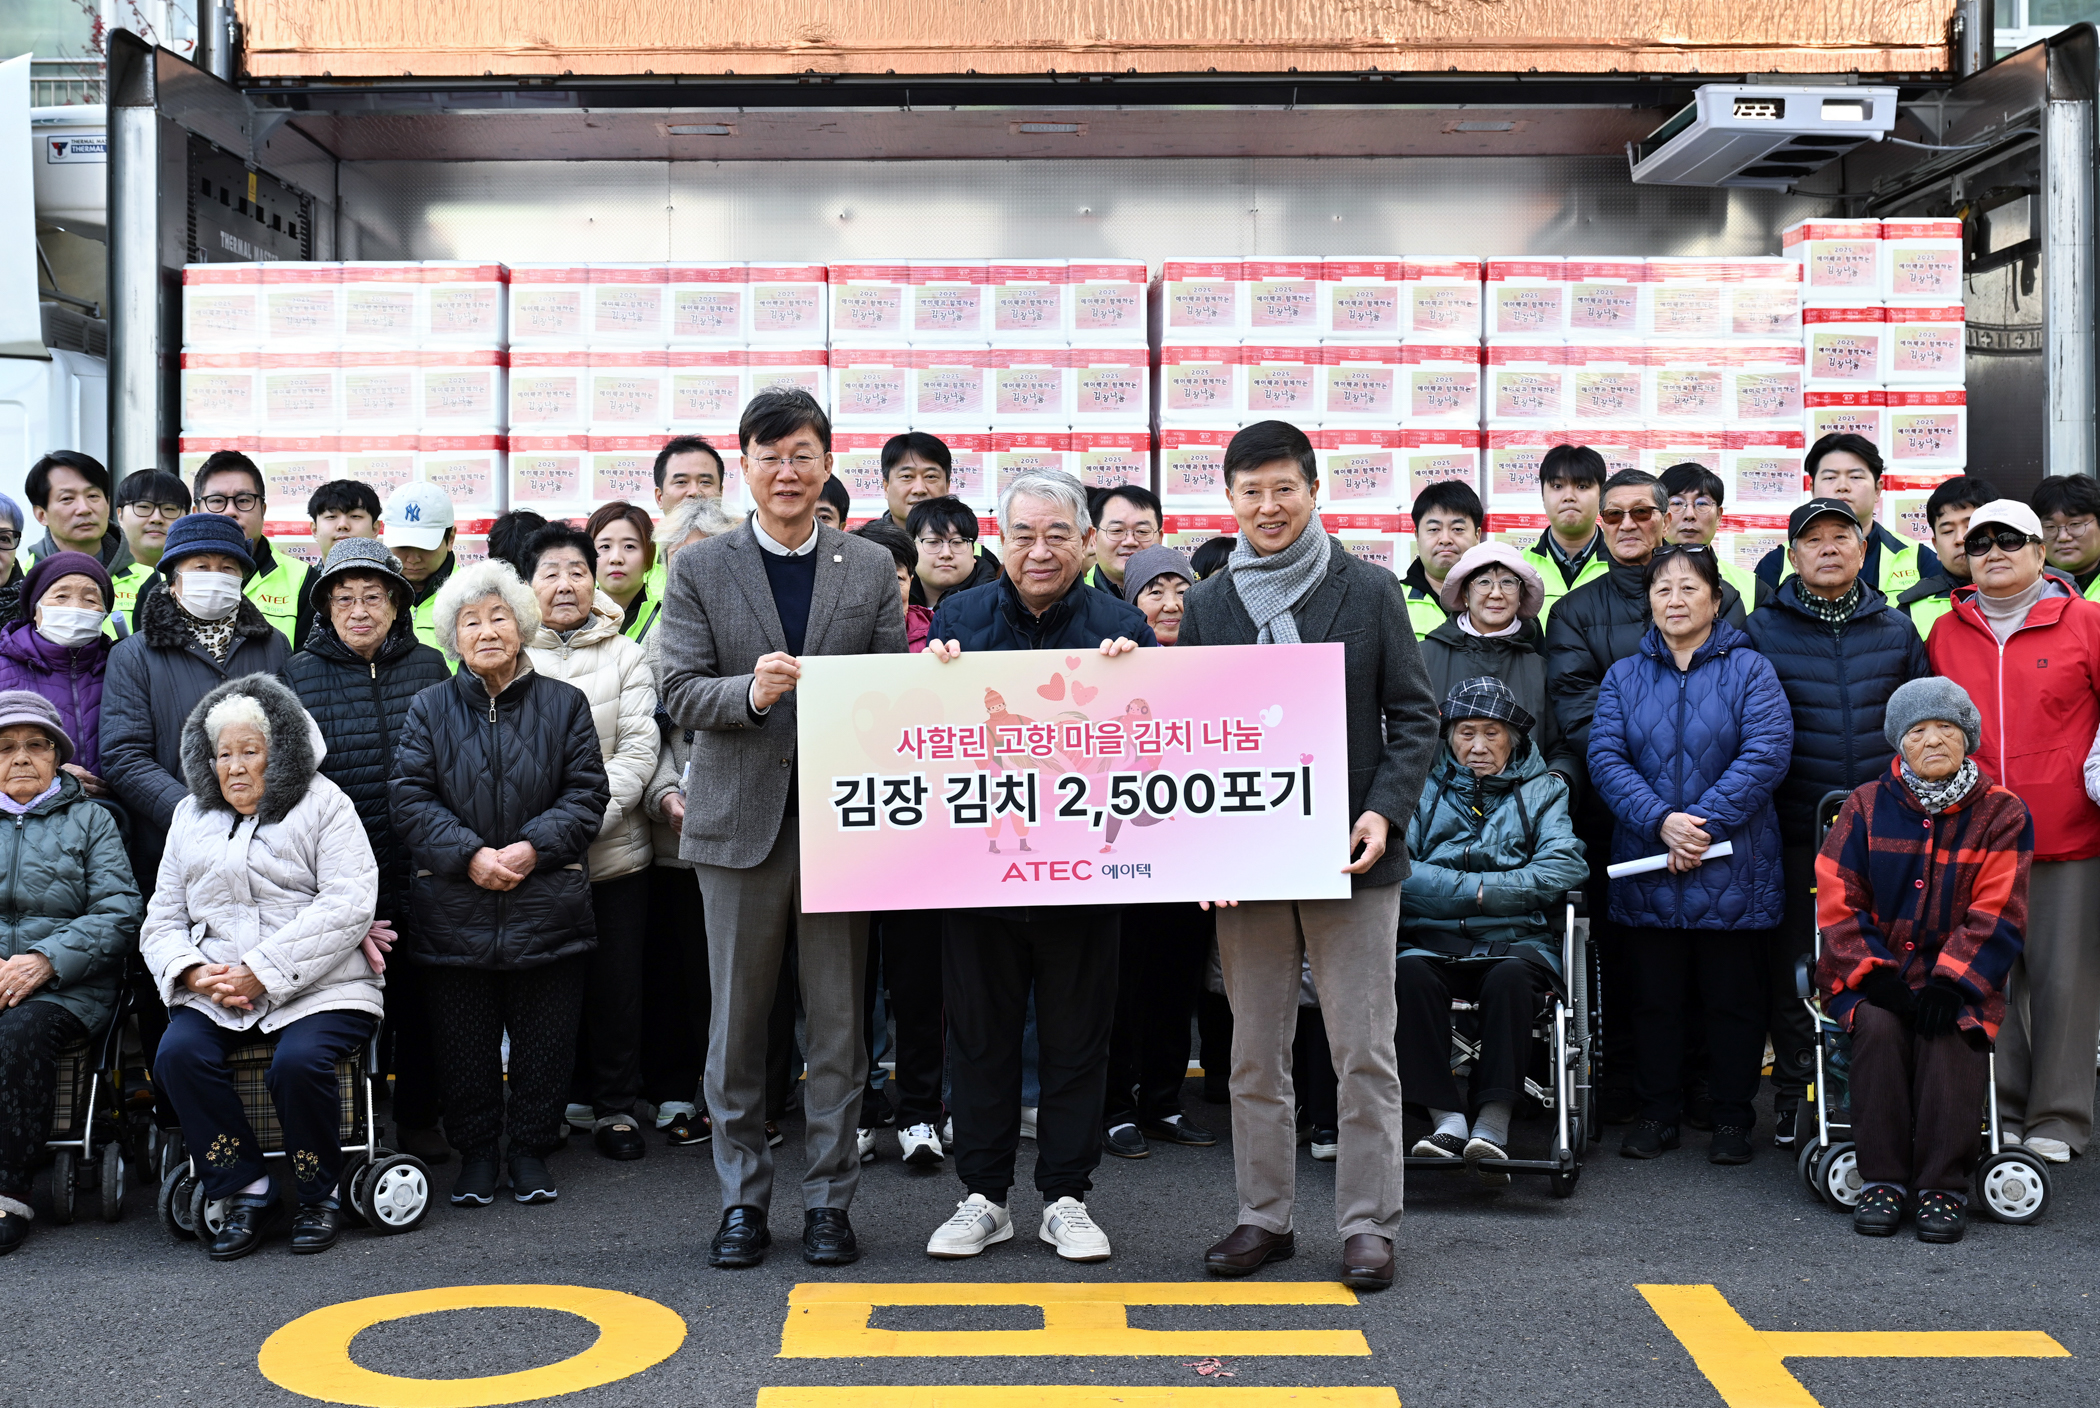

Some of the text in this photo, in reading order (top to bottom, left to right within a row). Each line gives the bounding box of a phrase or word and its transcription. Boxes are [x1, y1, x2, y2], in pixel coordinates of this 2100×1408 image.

[220, 230, 252, 260] THERMAL
[1826, 265, 1859, 277] 김장나눔
[1909, 272, 1942, 285] 김장나눔
[770, 309, 802, 322] 김장나눔
[850, 308, 883, 322] 김장나눔
[1091, 307, 1123, 320] 김장나눔
[1185, 305, 1218, 318] 김장나눔
[1267, 304, 1299, 317] 김장나눔
[1348, 309, 1381, 322] 김장나눔
[1586, 306, 1619, 320] 김장나눔
[1910, 349, 1942, 362] 김장나눔
[1827, 356, 1860, 370] 김장나눔
[855, 392, 888, 404] 김장나눔
[1012, 392, 1045, 404] 김장나눔
[1093, 391, 1126, 403] 김장나눔
[1183, 387, 1216, 400] 김장나눔
[1264, 389, 1297, 401] 김장나눔
[1343, 390, 1376, 404] 김장나눔
[609, 400, 642, 413] 김장나눔
[1427, 395, 1460, 407] 김장나눔
[1908, 437, 1941, 450] 김장나눔
[442, 482, 475, 496] 김장나눔
[530, 479, 562, 492] 김장나눔
[1344, 476, 1377, 490] 김장나눔
[405, 503, 421, 522] NY
[257, 594, 290, 604] ATEC
[897, 719, 1263, 760] 사할린 고향 마을 김치 나눔
[834, 766, 1312, 828] 김장 김치 2,500포기
[1001, 859, 1152, 883] ATEC 에이텍
